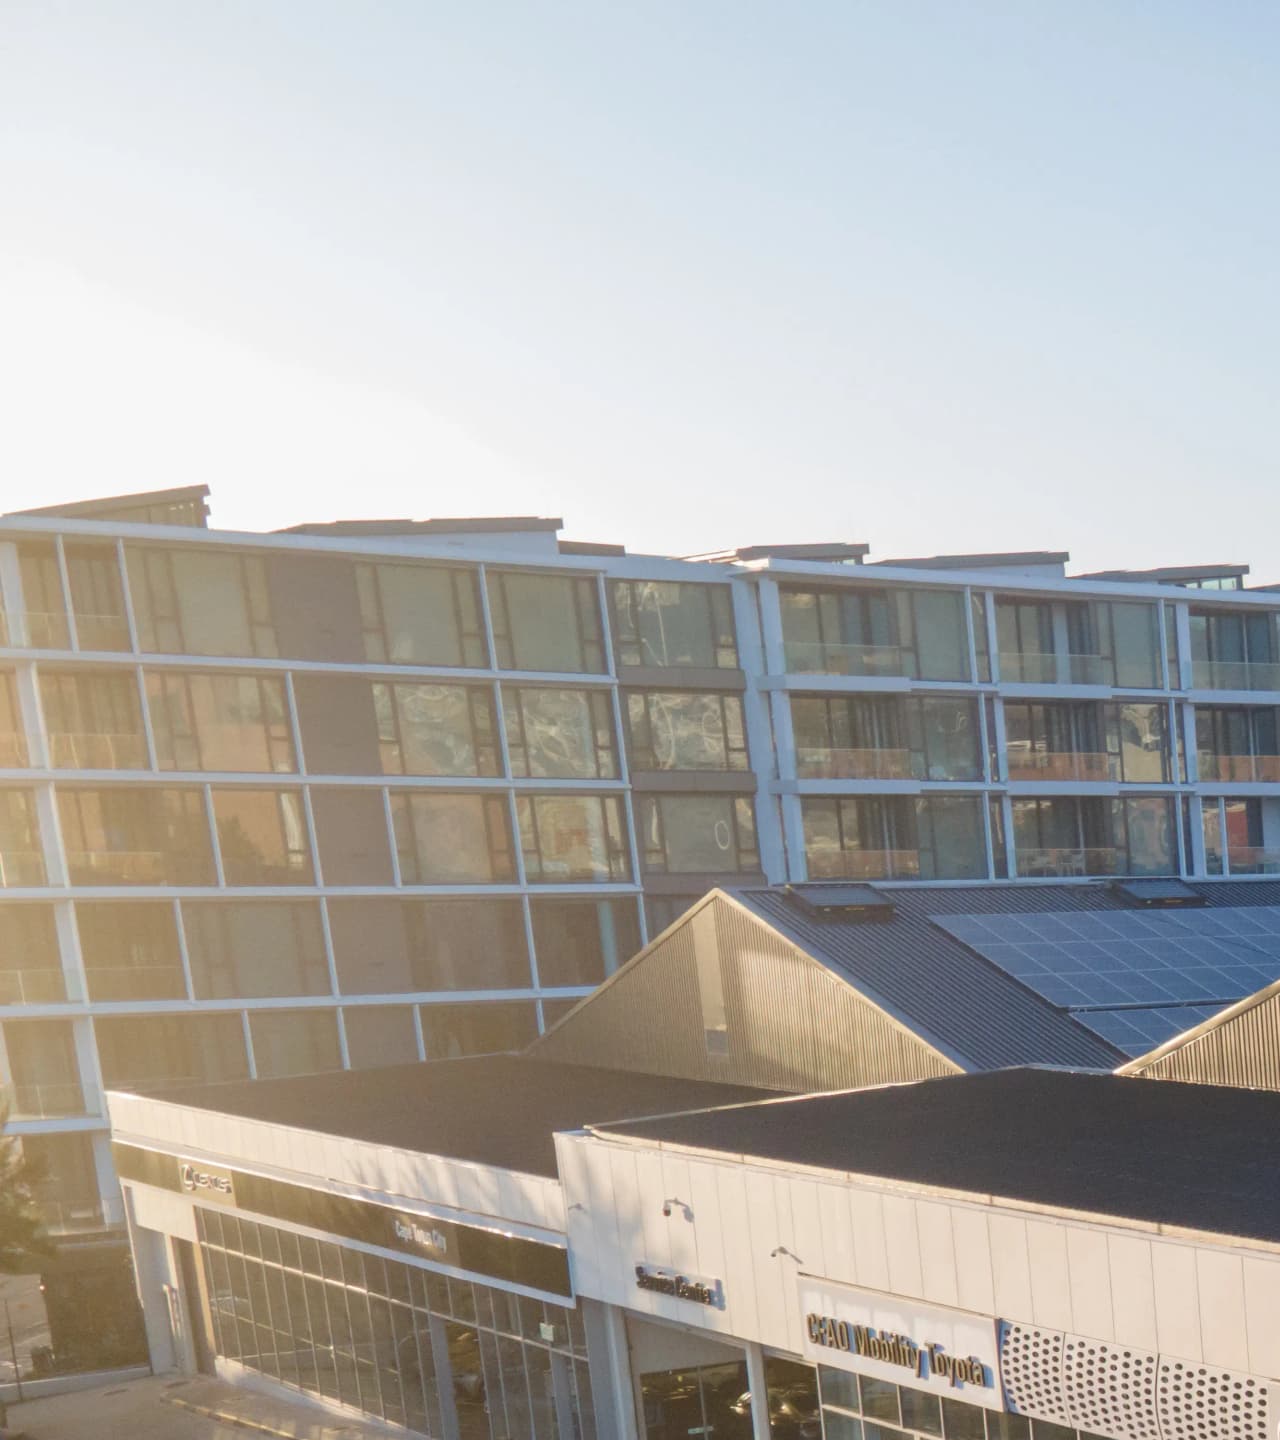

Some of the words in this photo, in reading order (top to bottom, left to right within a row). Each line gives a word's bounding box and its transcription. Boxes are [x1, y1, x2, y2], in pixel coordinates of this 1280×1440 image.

[806, 1313, 850, 1351] CFAO
[853, 1323, 922, 1379] Mobility
[924, 1341, 986, 1388] Toyota
